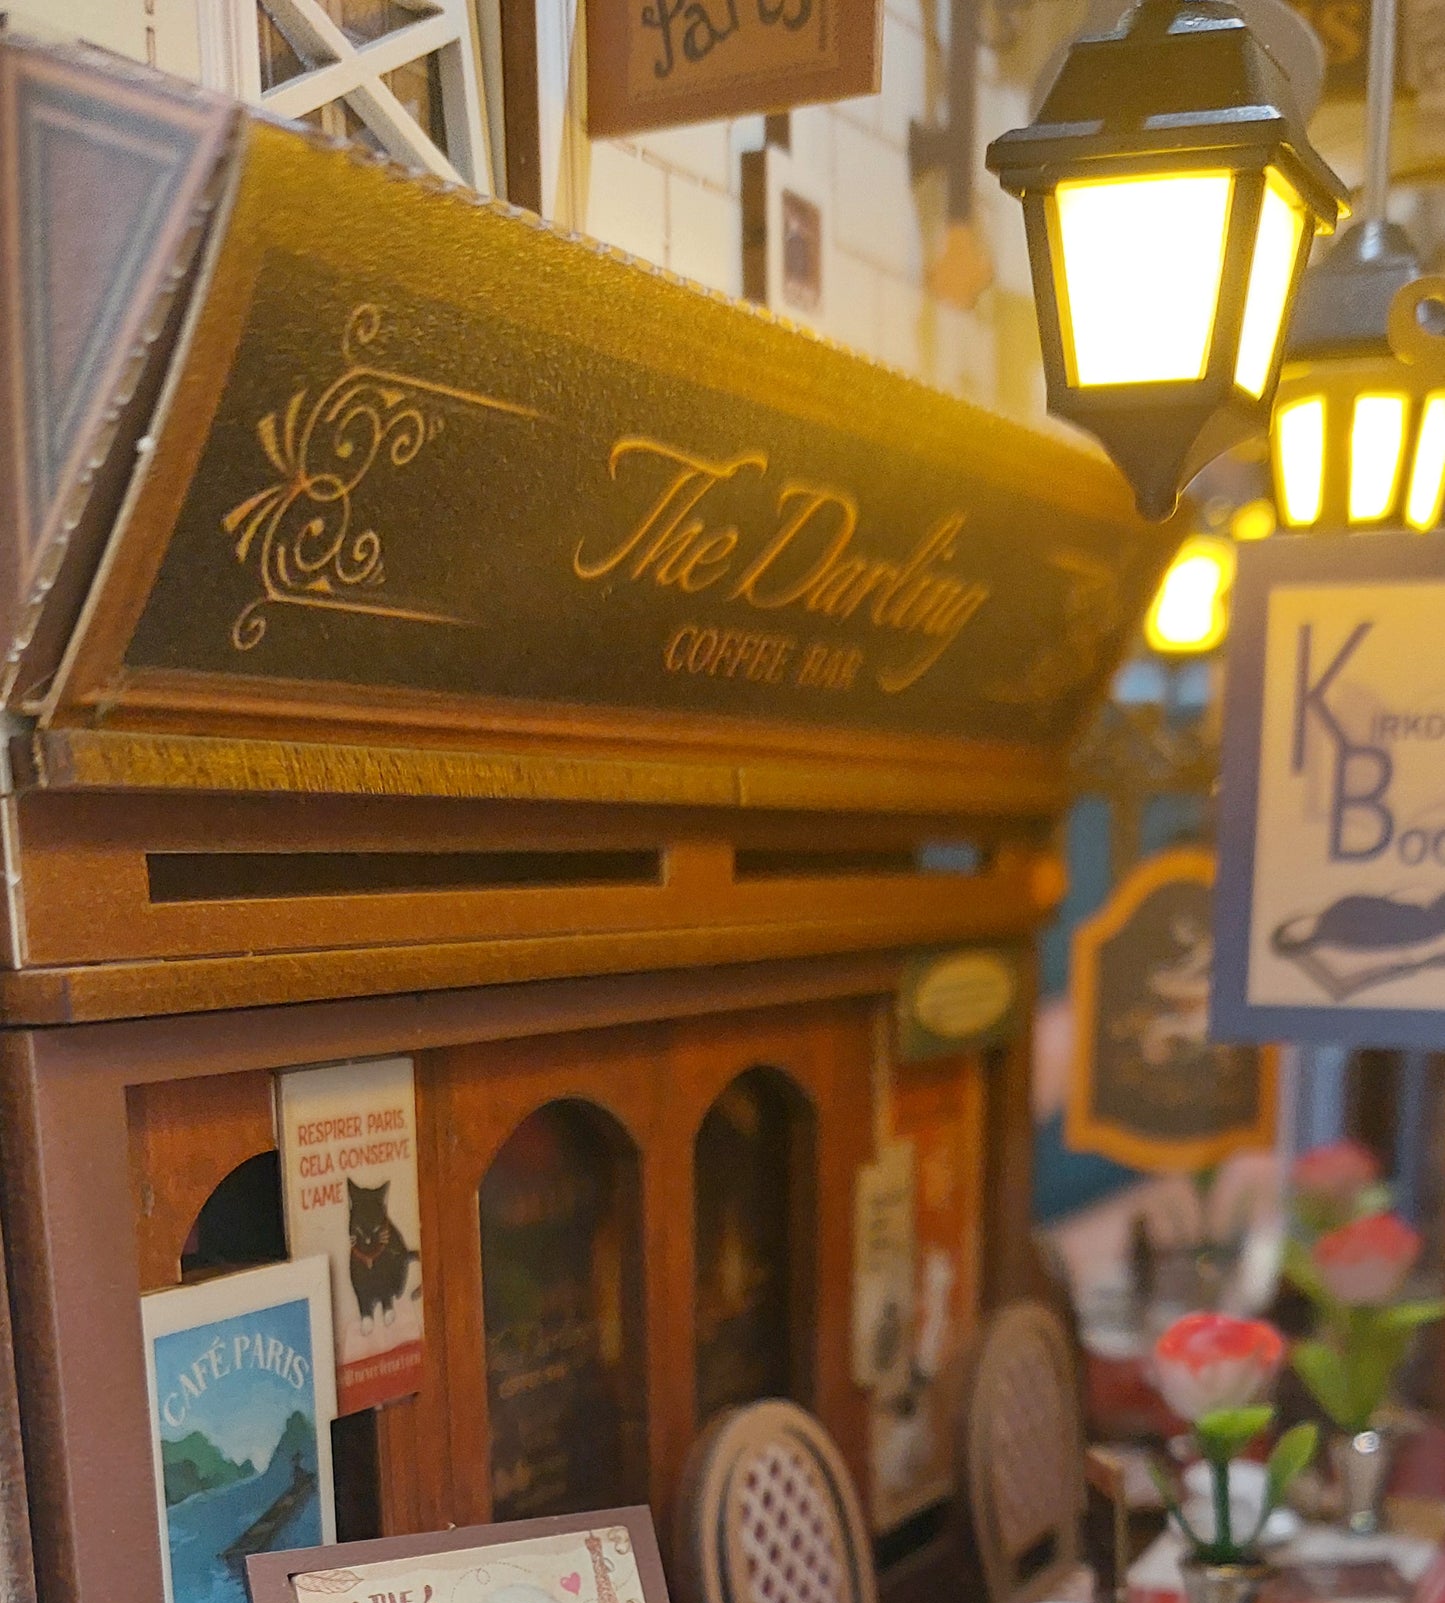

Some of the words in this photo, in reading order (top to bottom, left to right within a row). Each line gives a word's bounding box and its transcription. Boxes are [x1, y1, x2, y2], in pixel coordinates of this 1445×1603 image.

[573, 434, 768, 593] The
[727, 484, 990, 693] Darling
[664, 625, 795, 684] COFFEE
[797, 642, 863, 689] BAR
[297, 1115, 362, 1147] RESPIRER
[163, 1335, 231, 1427] CAFÉ
[234, 1332, 310, 1390] PARIS
